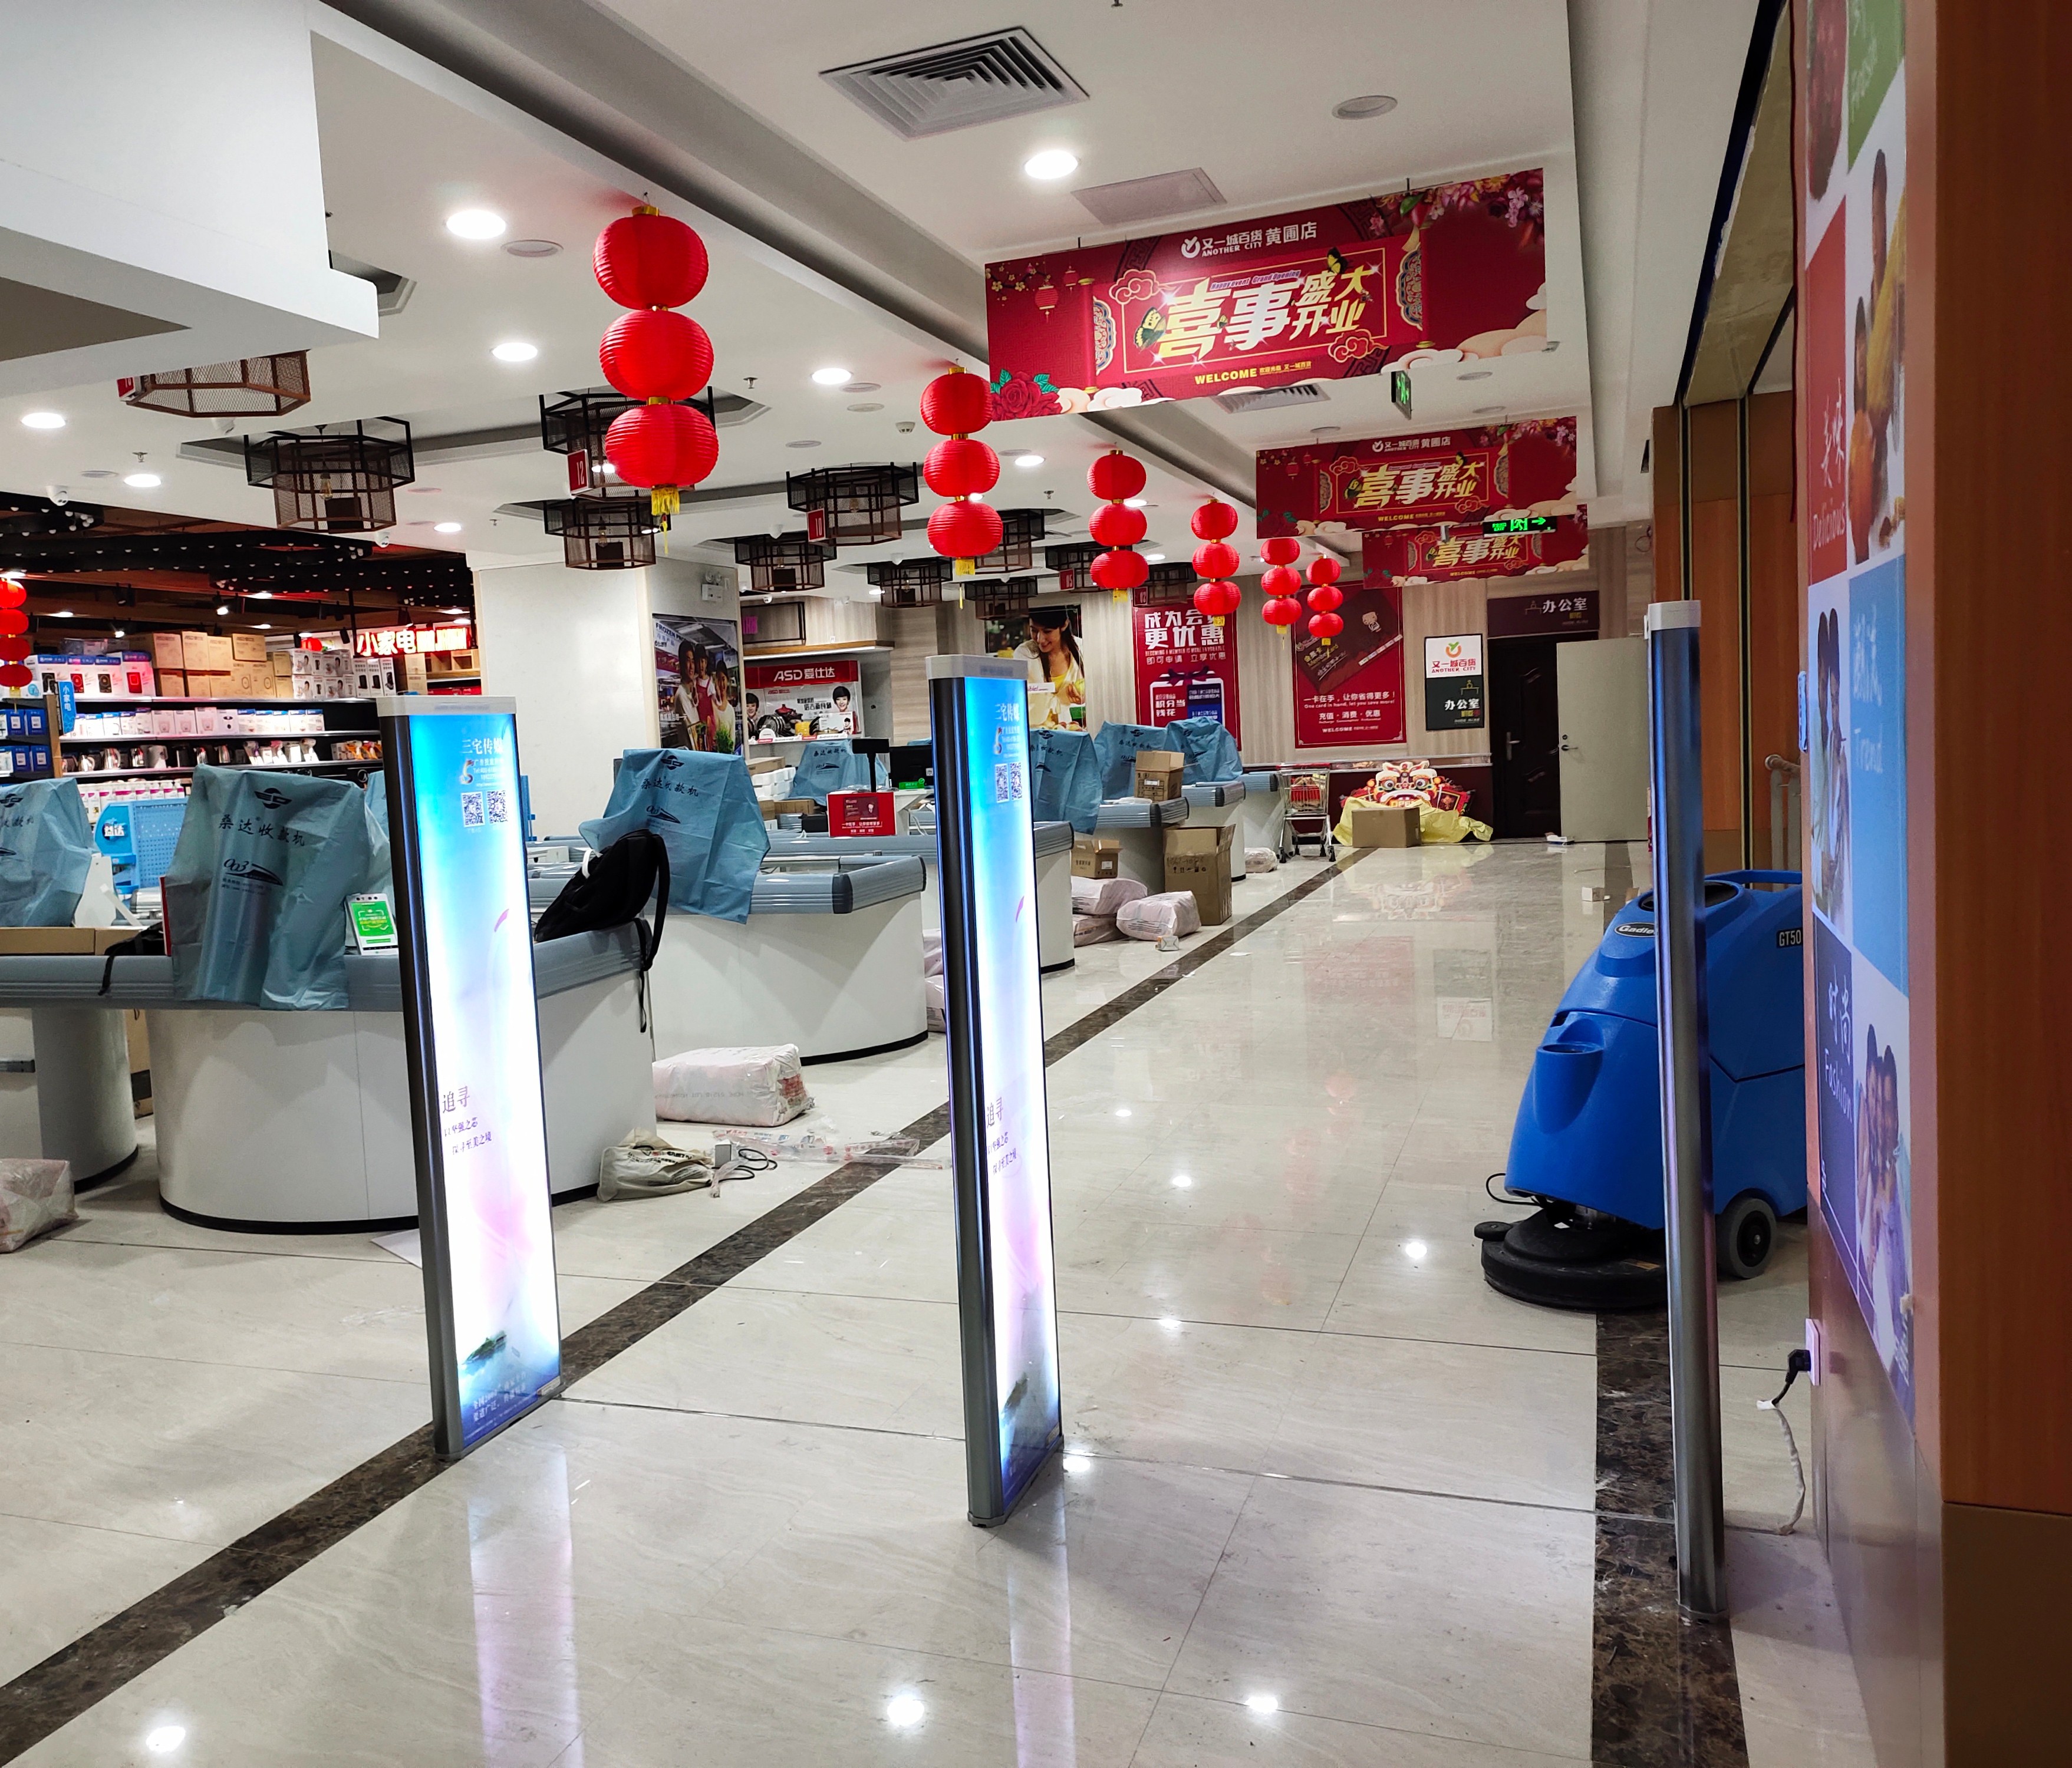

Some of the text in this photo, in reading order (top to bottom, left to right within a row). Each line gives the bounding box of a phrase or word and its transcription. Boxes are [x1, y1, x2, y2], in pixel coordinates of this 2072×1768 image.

[1201, 222, 1317, 250] 又一城百货 黄圃店
[1201, 241, 1263, 257] ANOTHER CITY
[1157, 276, 1303, 361] 喜事
[1290, 297, 1366, 341] 开业
[1195, 368, 1257, 385] WELCOME
[577, 461, 585, 486] 12
[815, 517, 822, 537] 10
[1378, 513, 1414, 522] WELCOME
[1542, 598, 1587, 613] 办公室
[656, 622, 676, 638] FROZEN
[1144, 625, 1224, 649] 更优惠
[357, 629, 416, 657] 小家电
[773, 667, 835, 682] ASD 爱仕达
[62, 685, 71, 711] 小家电
[1444, 698, 1480, 711] 办公室
[1619, 925, 1655, 935] Gadle
[1779, 929, 1801, 946] GT50
[1824, 1047, 1853, 1124] Fashion
[442, 1085, 470, 1113] 追寻
[987, 1097, 1004, 1129] 追寻
